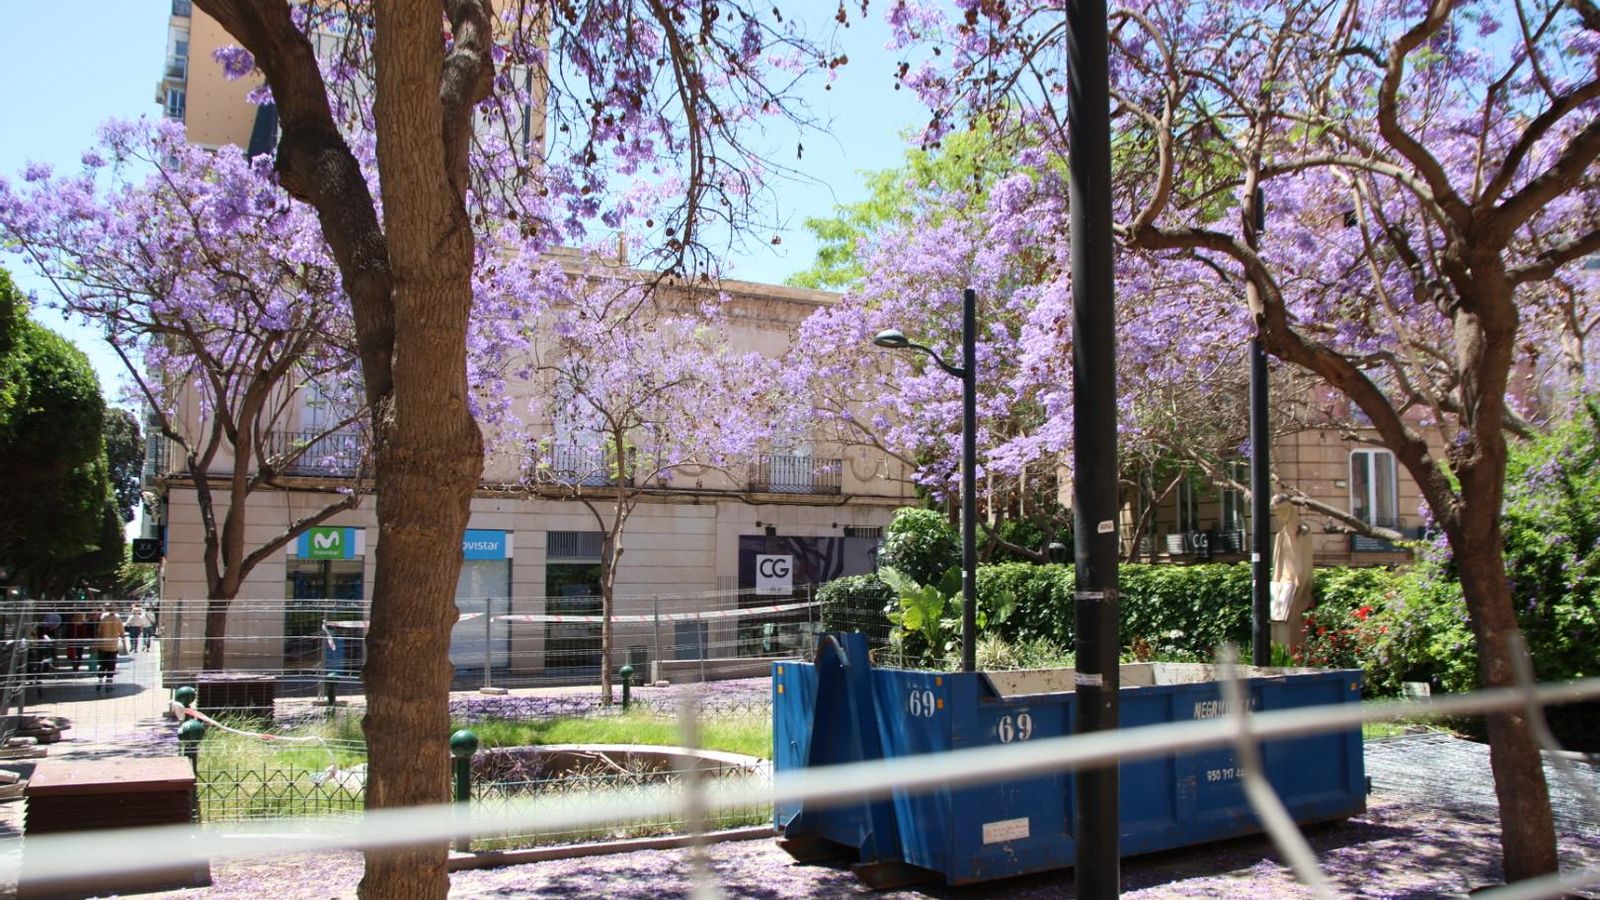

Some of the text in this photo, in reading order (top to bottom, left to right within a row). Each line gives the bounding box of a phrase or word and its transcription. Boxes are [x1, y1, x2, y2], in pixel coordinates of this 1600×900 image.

[462, 541, 499, 551] ovistar
[760, 558, 790, 579] CG
[909, 690, 935, 718] 69
[998, 713, 1033, 743] 69
